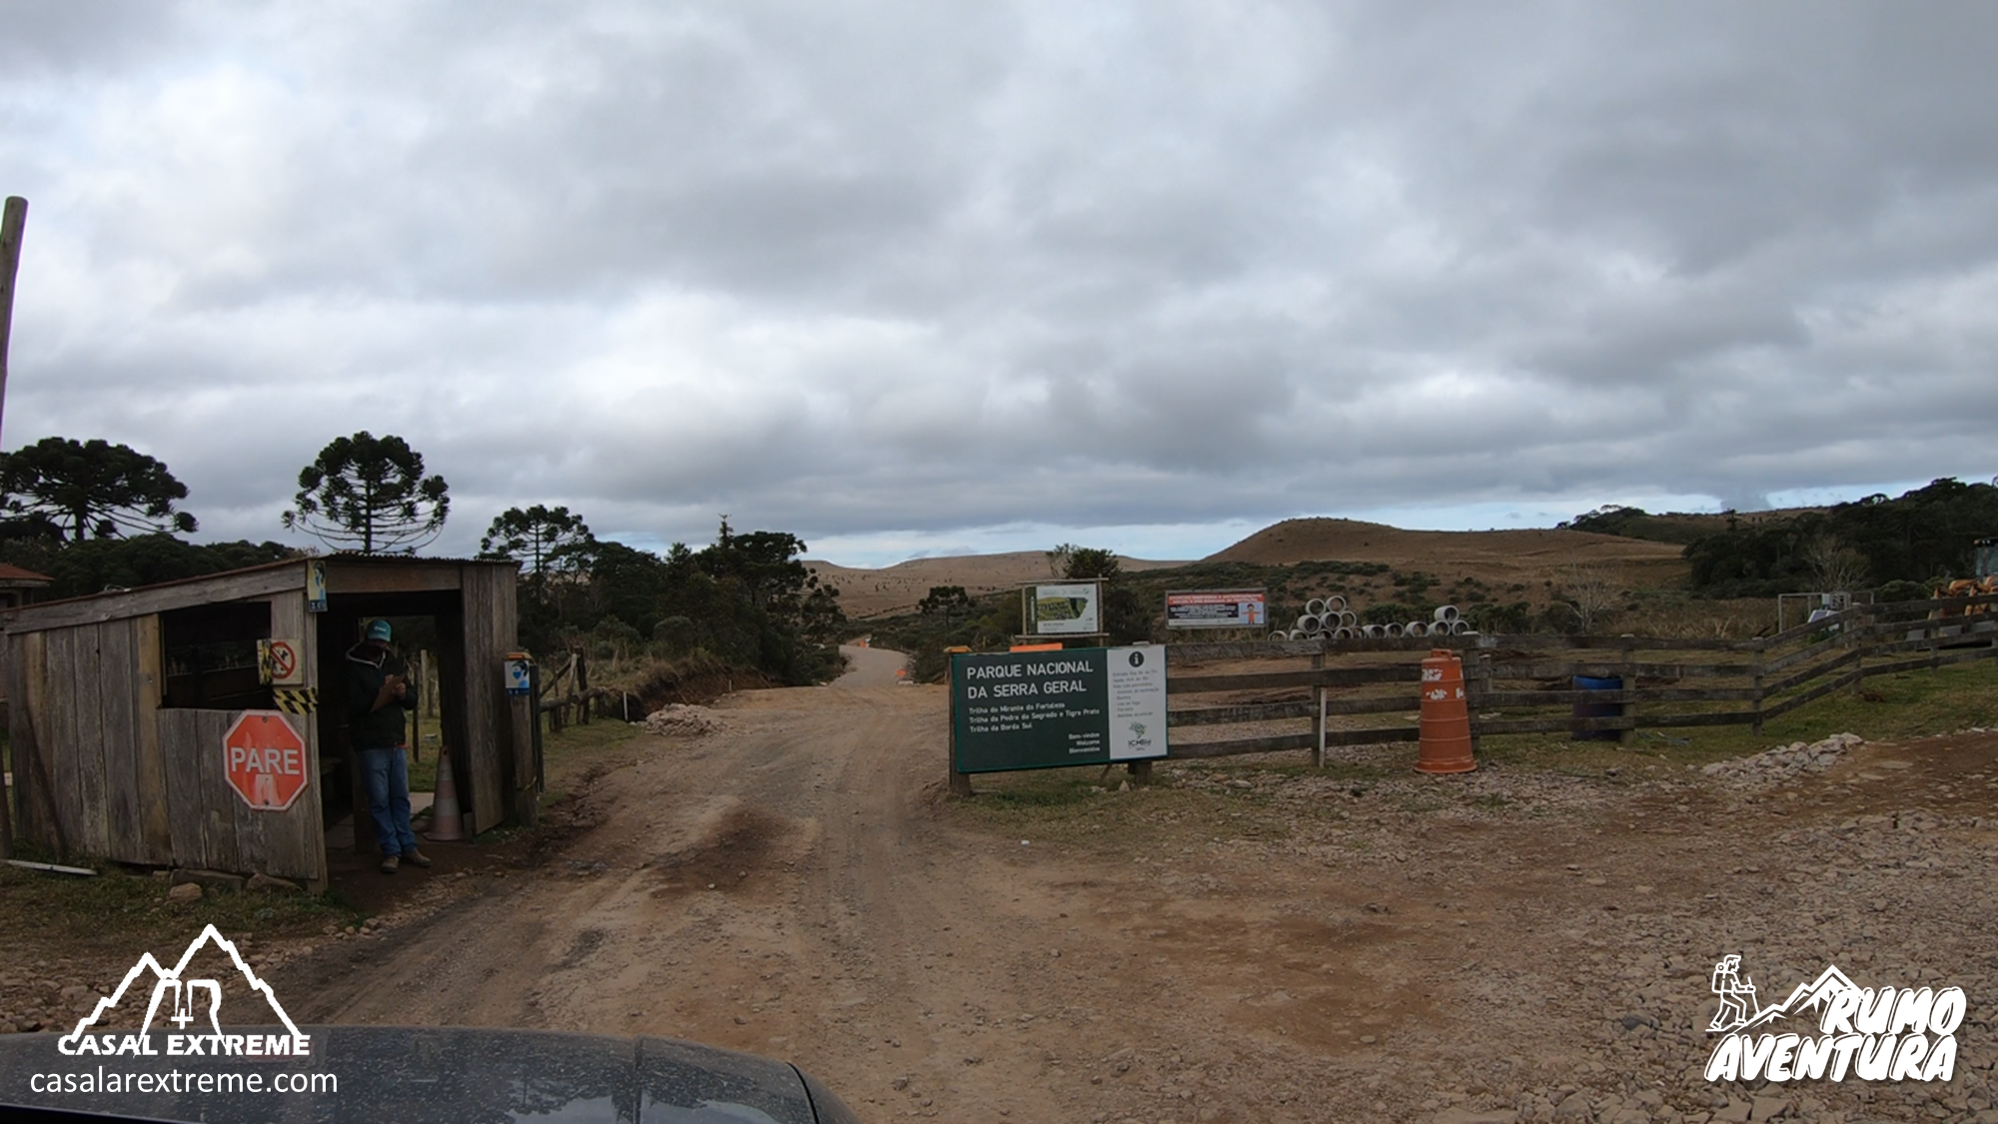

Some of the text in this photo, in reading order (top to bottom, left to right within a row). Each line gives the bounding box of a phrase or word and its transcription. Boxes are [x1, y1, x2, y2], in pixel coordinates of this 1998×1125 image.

[967, 661, 1093, 680] PARQUE NACIONAL
[968, 680, 1087, 699] DA SERRA GERAL
[1036, 702, 1065, 710] Fortaleza
[1031, 712, 1057, 720] Segredo
[1066, 710, 1081, 718] Tigre
[1000, 723, 1019, 731] Borda
[230, 747, 300, 775] PARE
